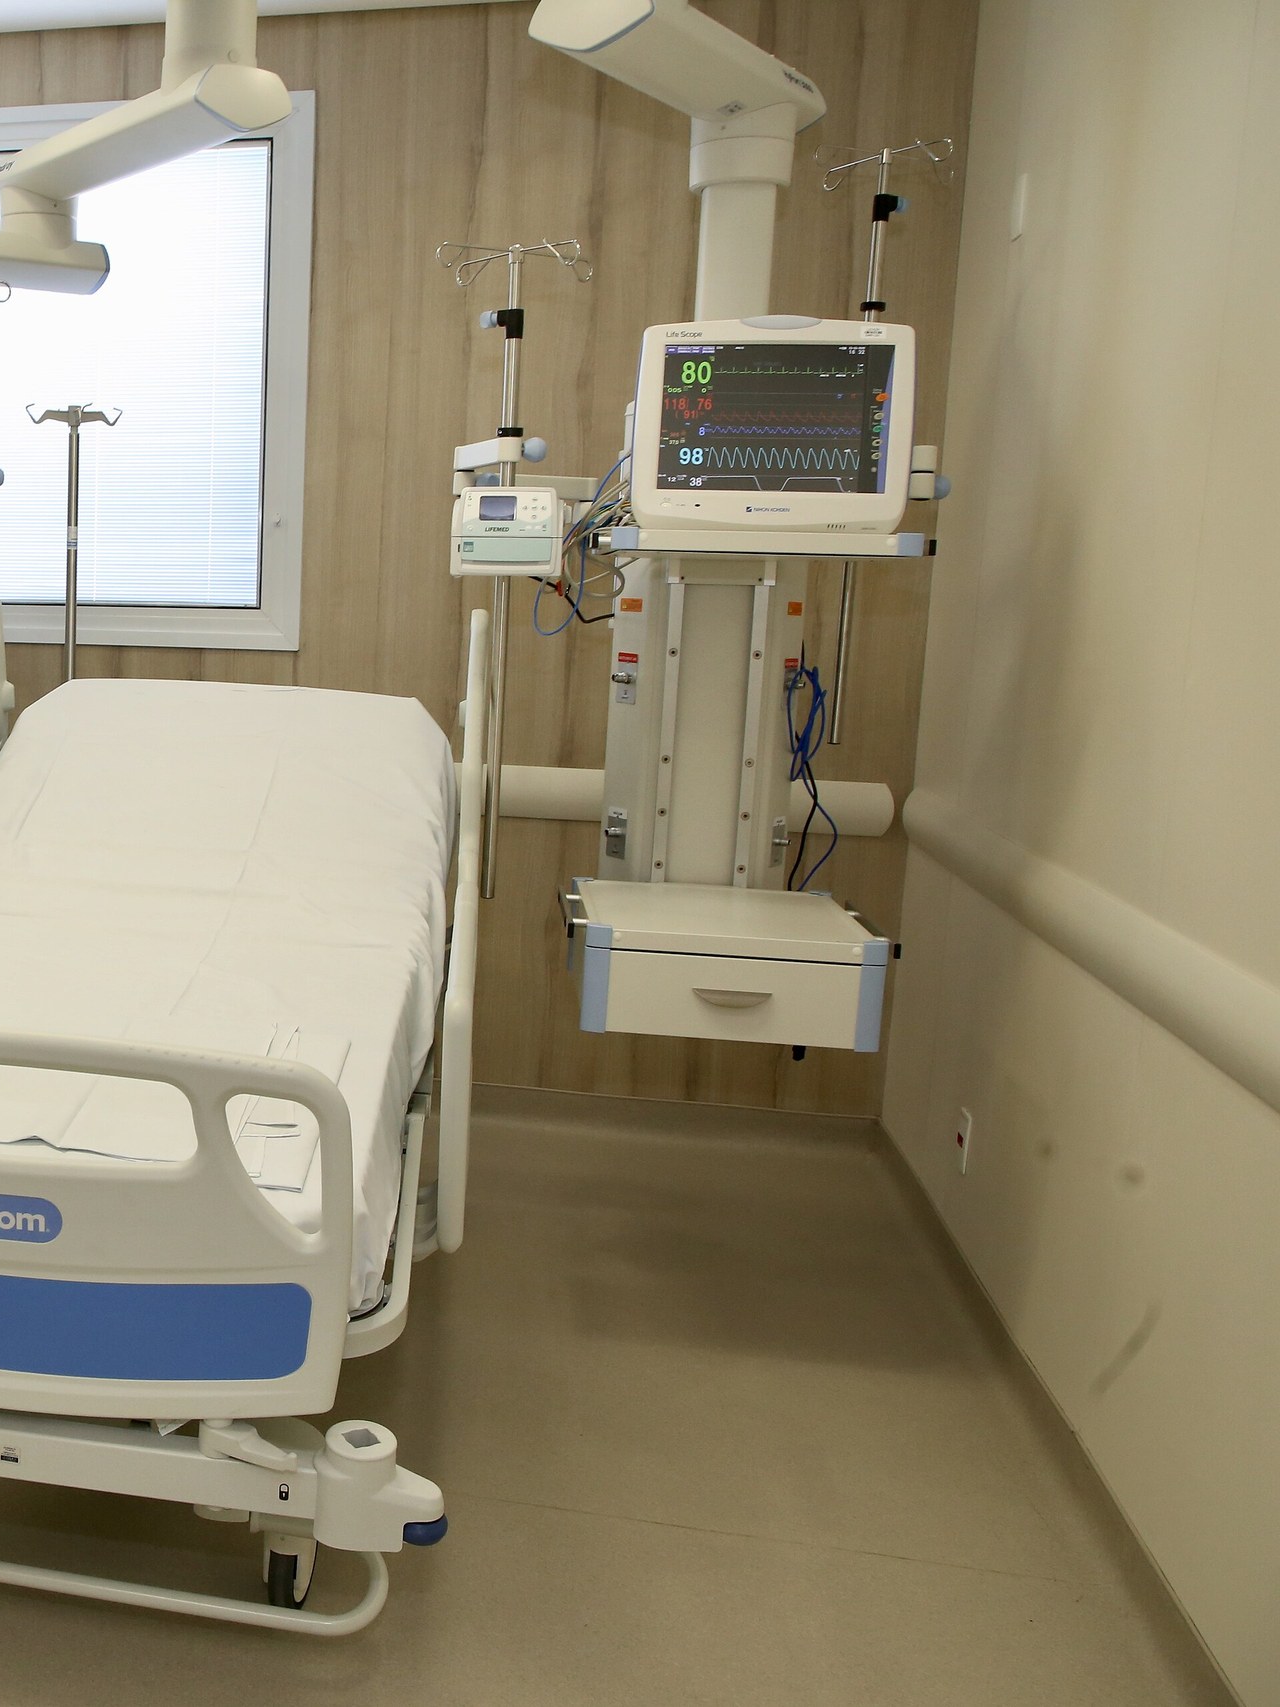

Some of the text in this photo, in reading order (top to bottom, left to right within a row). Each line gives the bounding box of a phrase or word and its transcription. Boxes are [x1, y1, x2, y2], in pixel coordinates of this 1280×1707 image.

[681, 361, 712, 384] 80
[697, 397, 712, 410] 76
[679, 447, 704, 465] 98
[689, 477, 703, 487] 38
